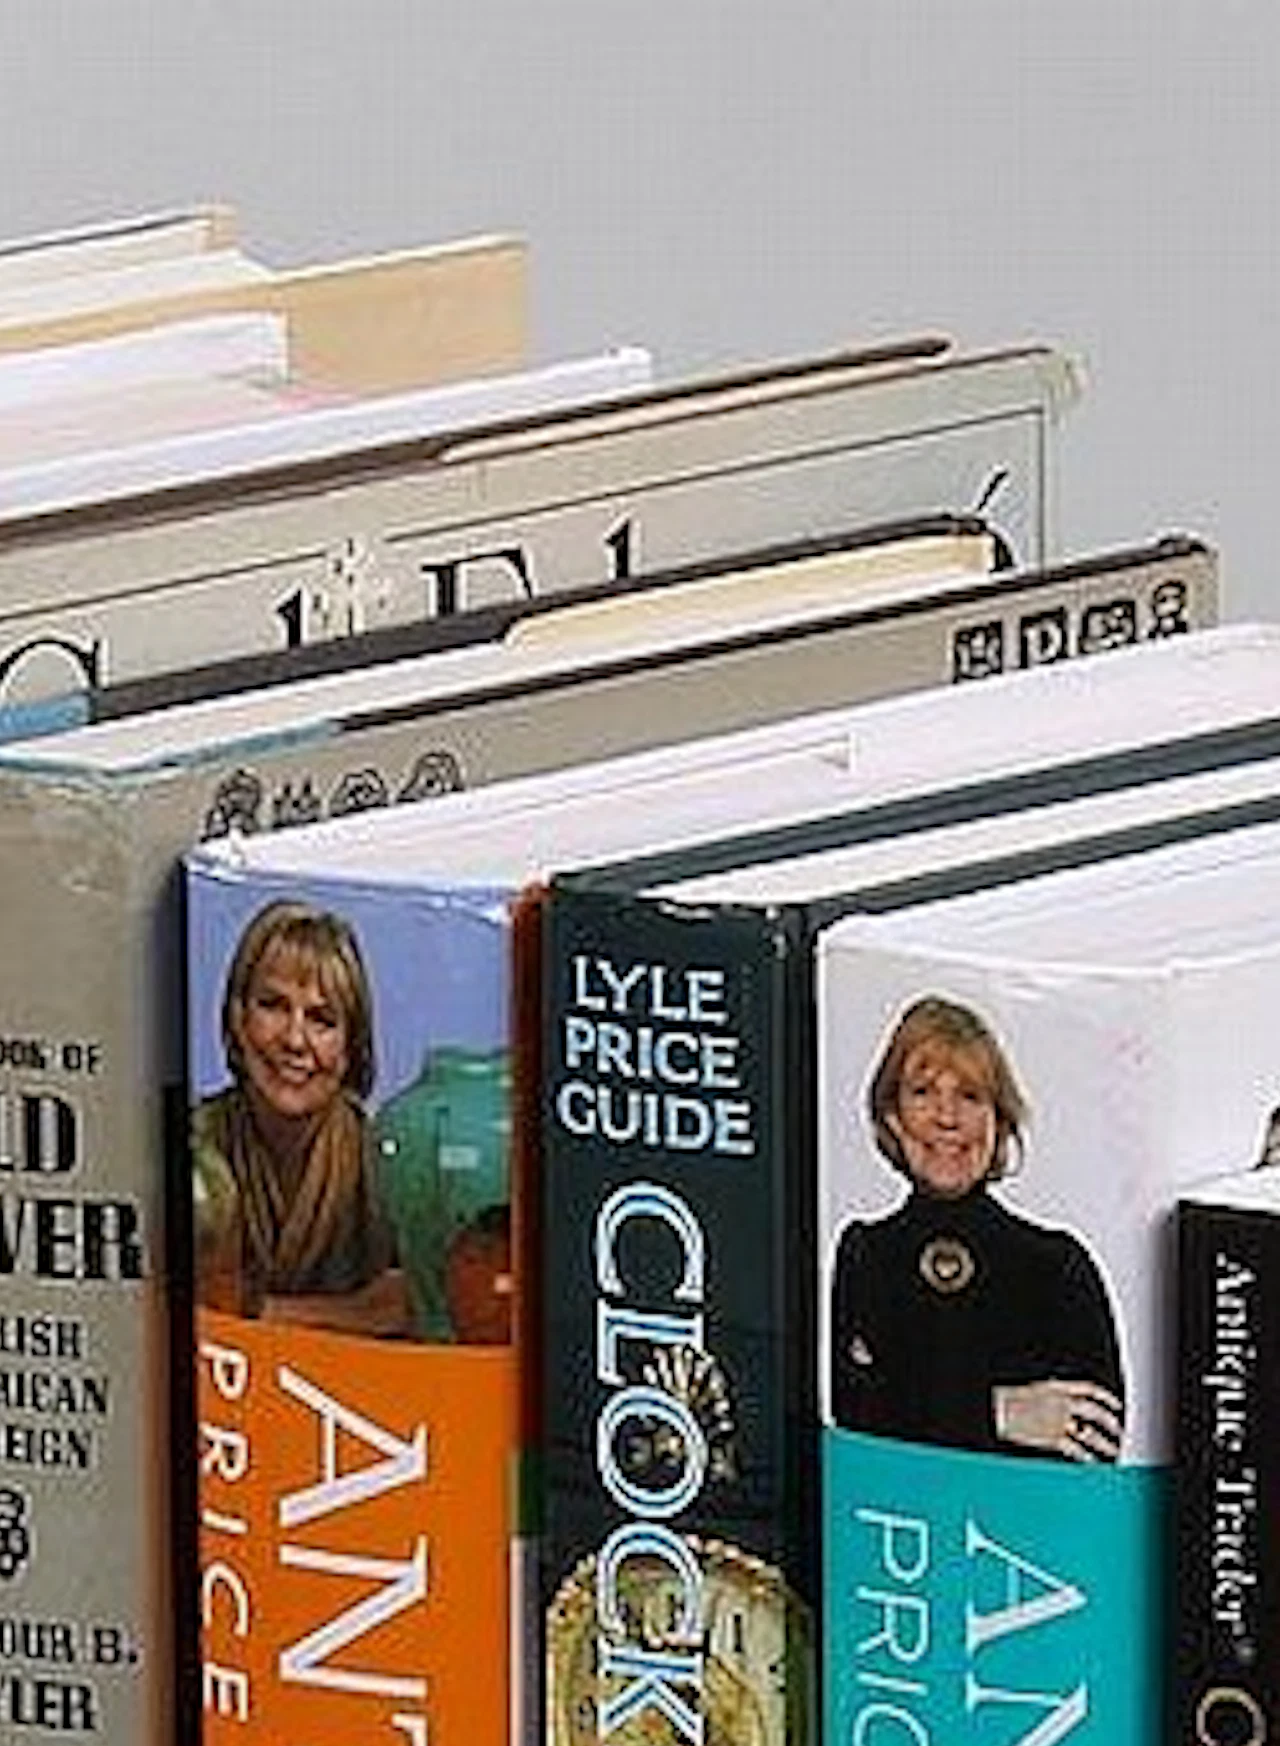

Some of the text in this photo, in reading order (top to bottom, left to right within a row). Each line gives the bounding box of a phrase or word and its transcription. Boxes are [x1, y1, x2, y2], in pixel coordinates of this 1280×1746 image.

[572, 953, 729, 1024] LYLE
[62, 1044, 101, 1074] OF
[564, 1016, 741, 1090] PRICE
[556, 1080, 756, 1155] GUIDE
[1201, 1252, 1258, 1454] Antique
[201, 1342, 249, 1722] PRICE
[93, 1627, 139, 1665] B.
